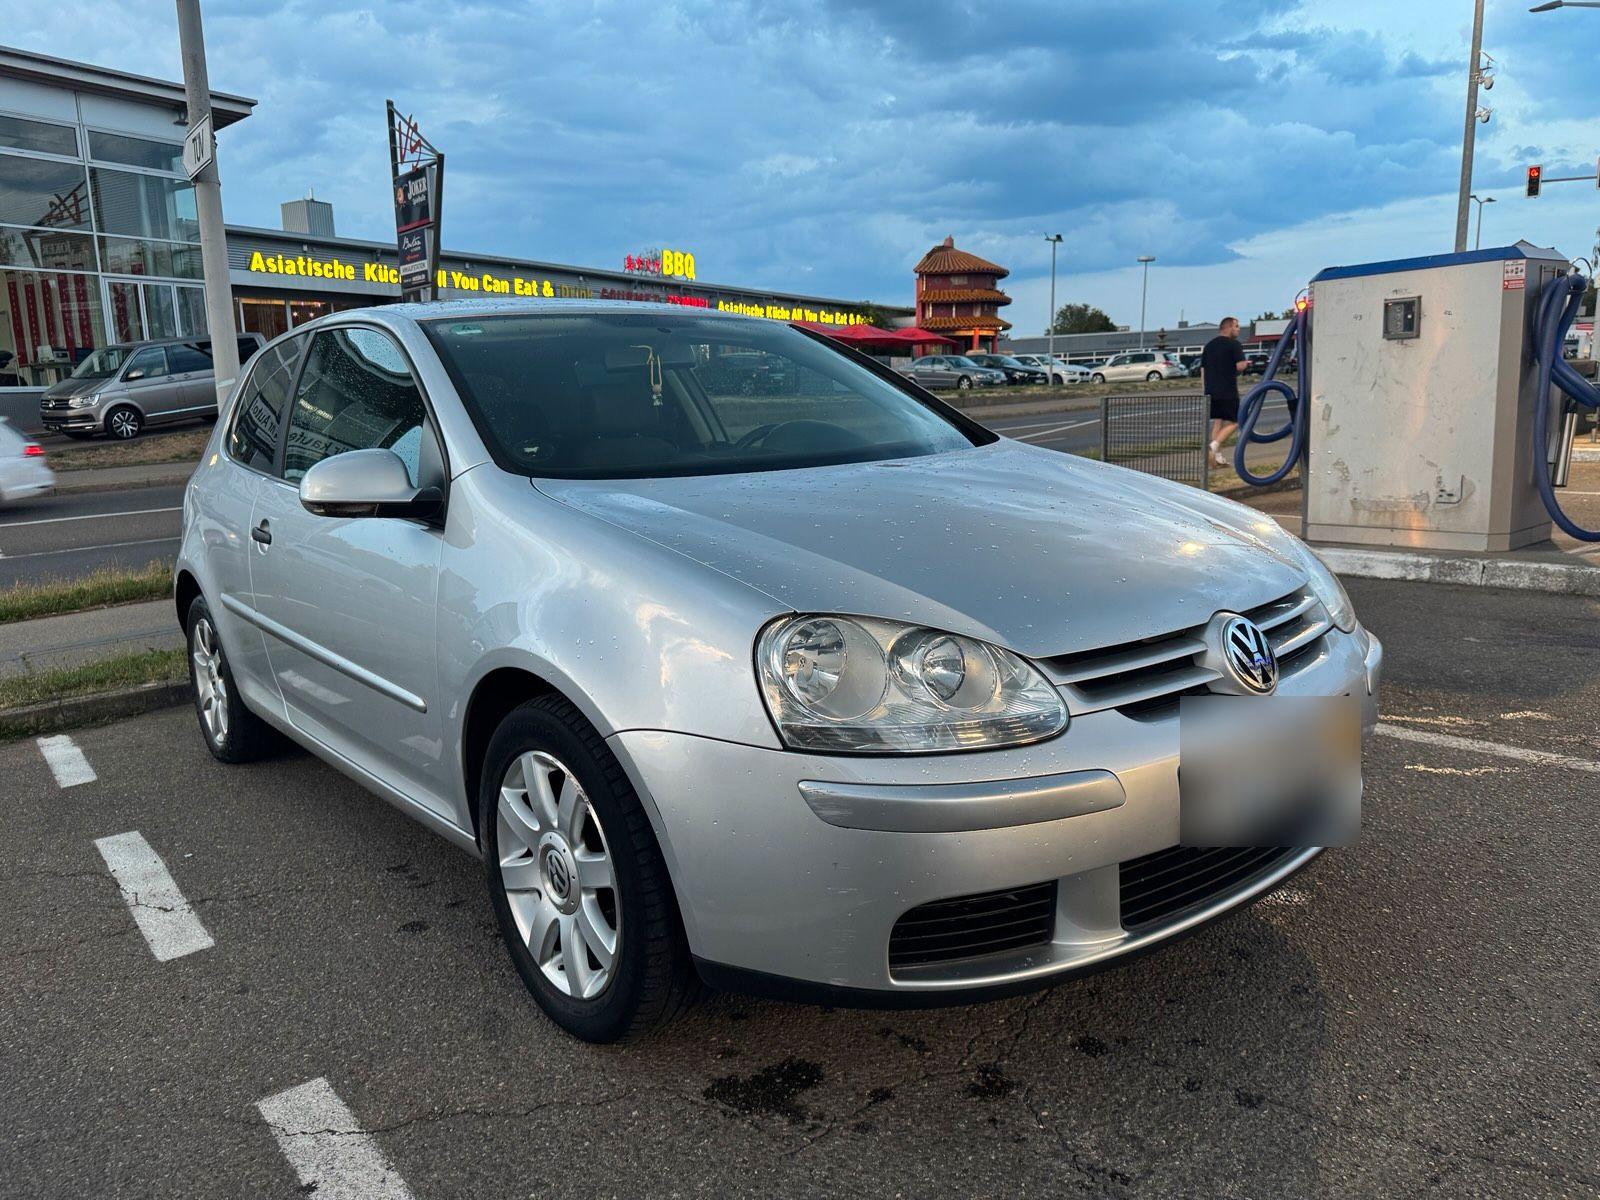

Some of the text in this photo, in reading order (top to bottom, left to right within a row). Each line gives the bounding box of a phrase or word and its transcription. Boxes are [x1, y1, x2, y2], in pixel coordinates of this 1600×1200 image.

[407, 176, 427, 200] JOKER
[249, 251, 356, 281] Asiatische
[364, 261, 402, 284] Küc
[451, 271, 479, 291] You
[482, 274, 510, 294] Can
[514, 277, 539, 297] Eat
[542, 280, 555, 298] &
[662, 249, 696, 280] BBQ
[717, 300, 765, 319] Asiatische
[765, 305, 791, 321] Küche
[791, 308, 803, 321] All
[803, 308, 818, 323] You
[819, 310, 835, 324] Can
[834, 312, 848, 326] Eat
[848, 313, 856, 326] &
